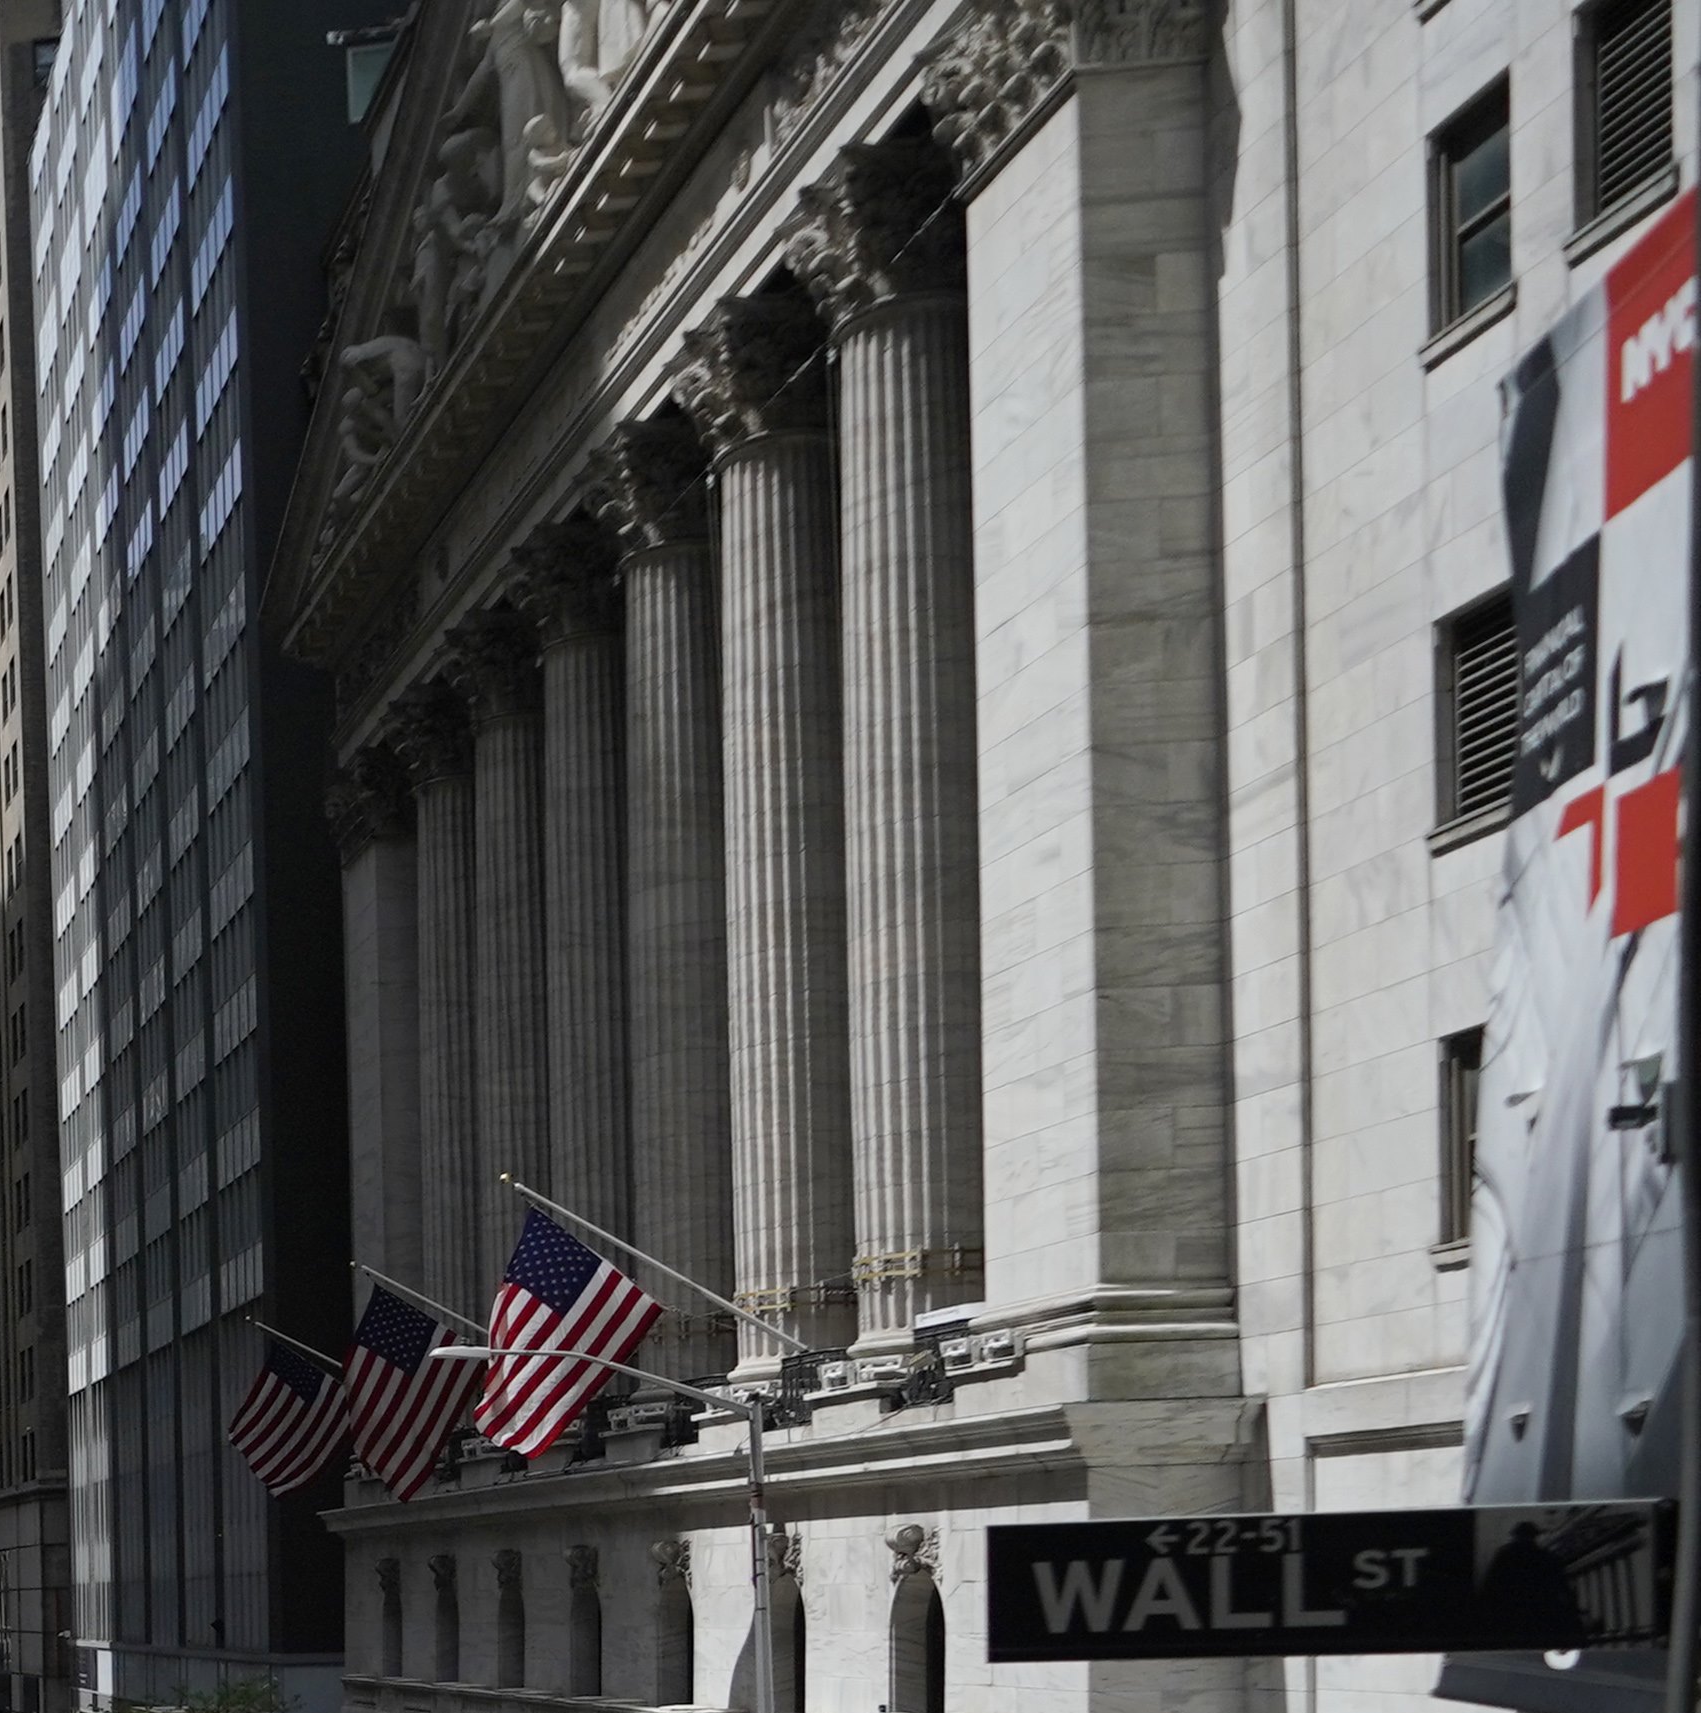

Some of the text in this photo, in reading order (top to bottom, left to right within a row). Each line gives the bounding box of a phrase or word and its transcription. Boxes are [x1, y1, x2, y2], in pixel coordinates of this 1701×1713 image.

[1185, 1518, 1302, 1555] 22-51
[1032, 1548, 1428, 1634] WALL ST
